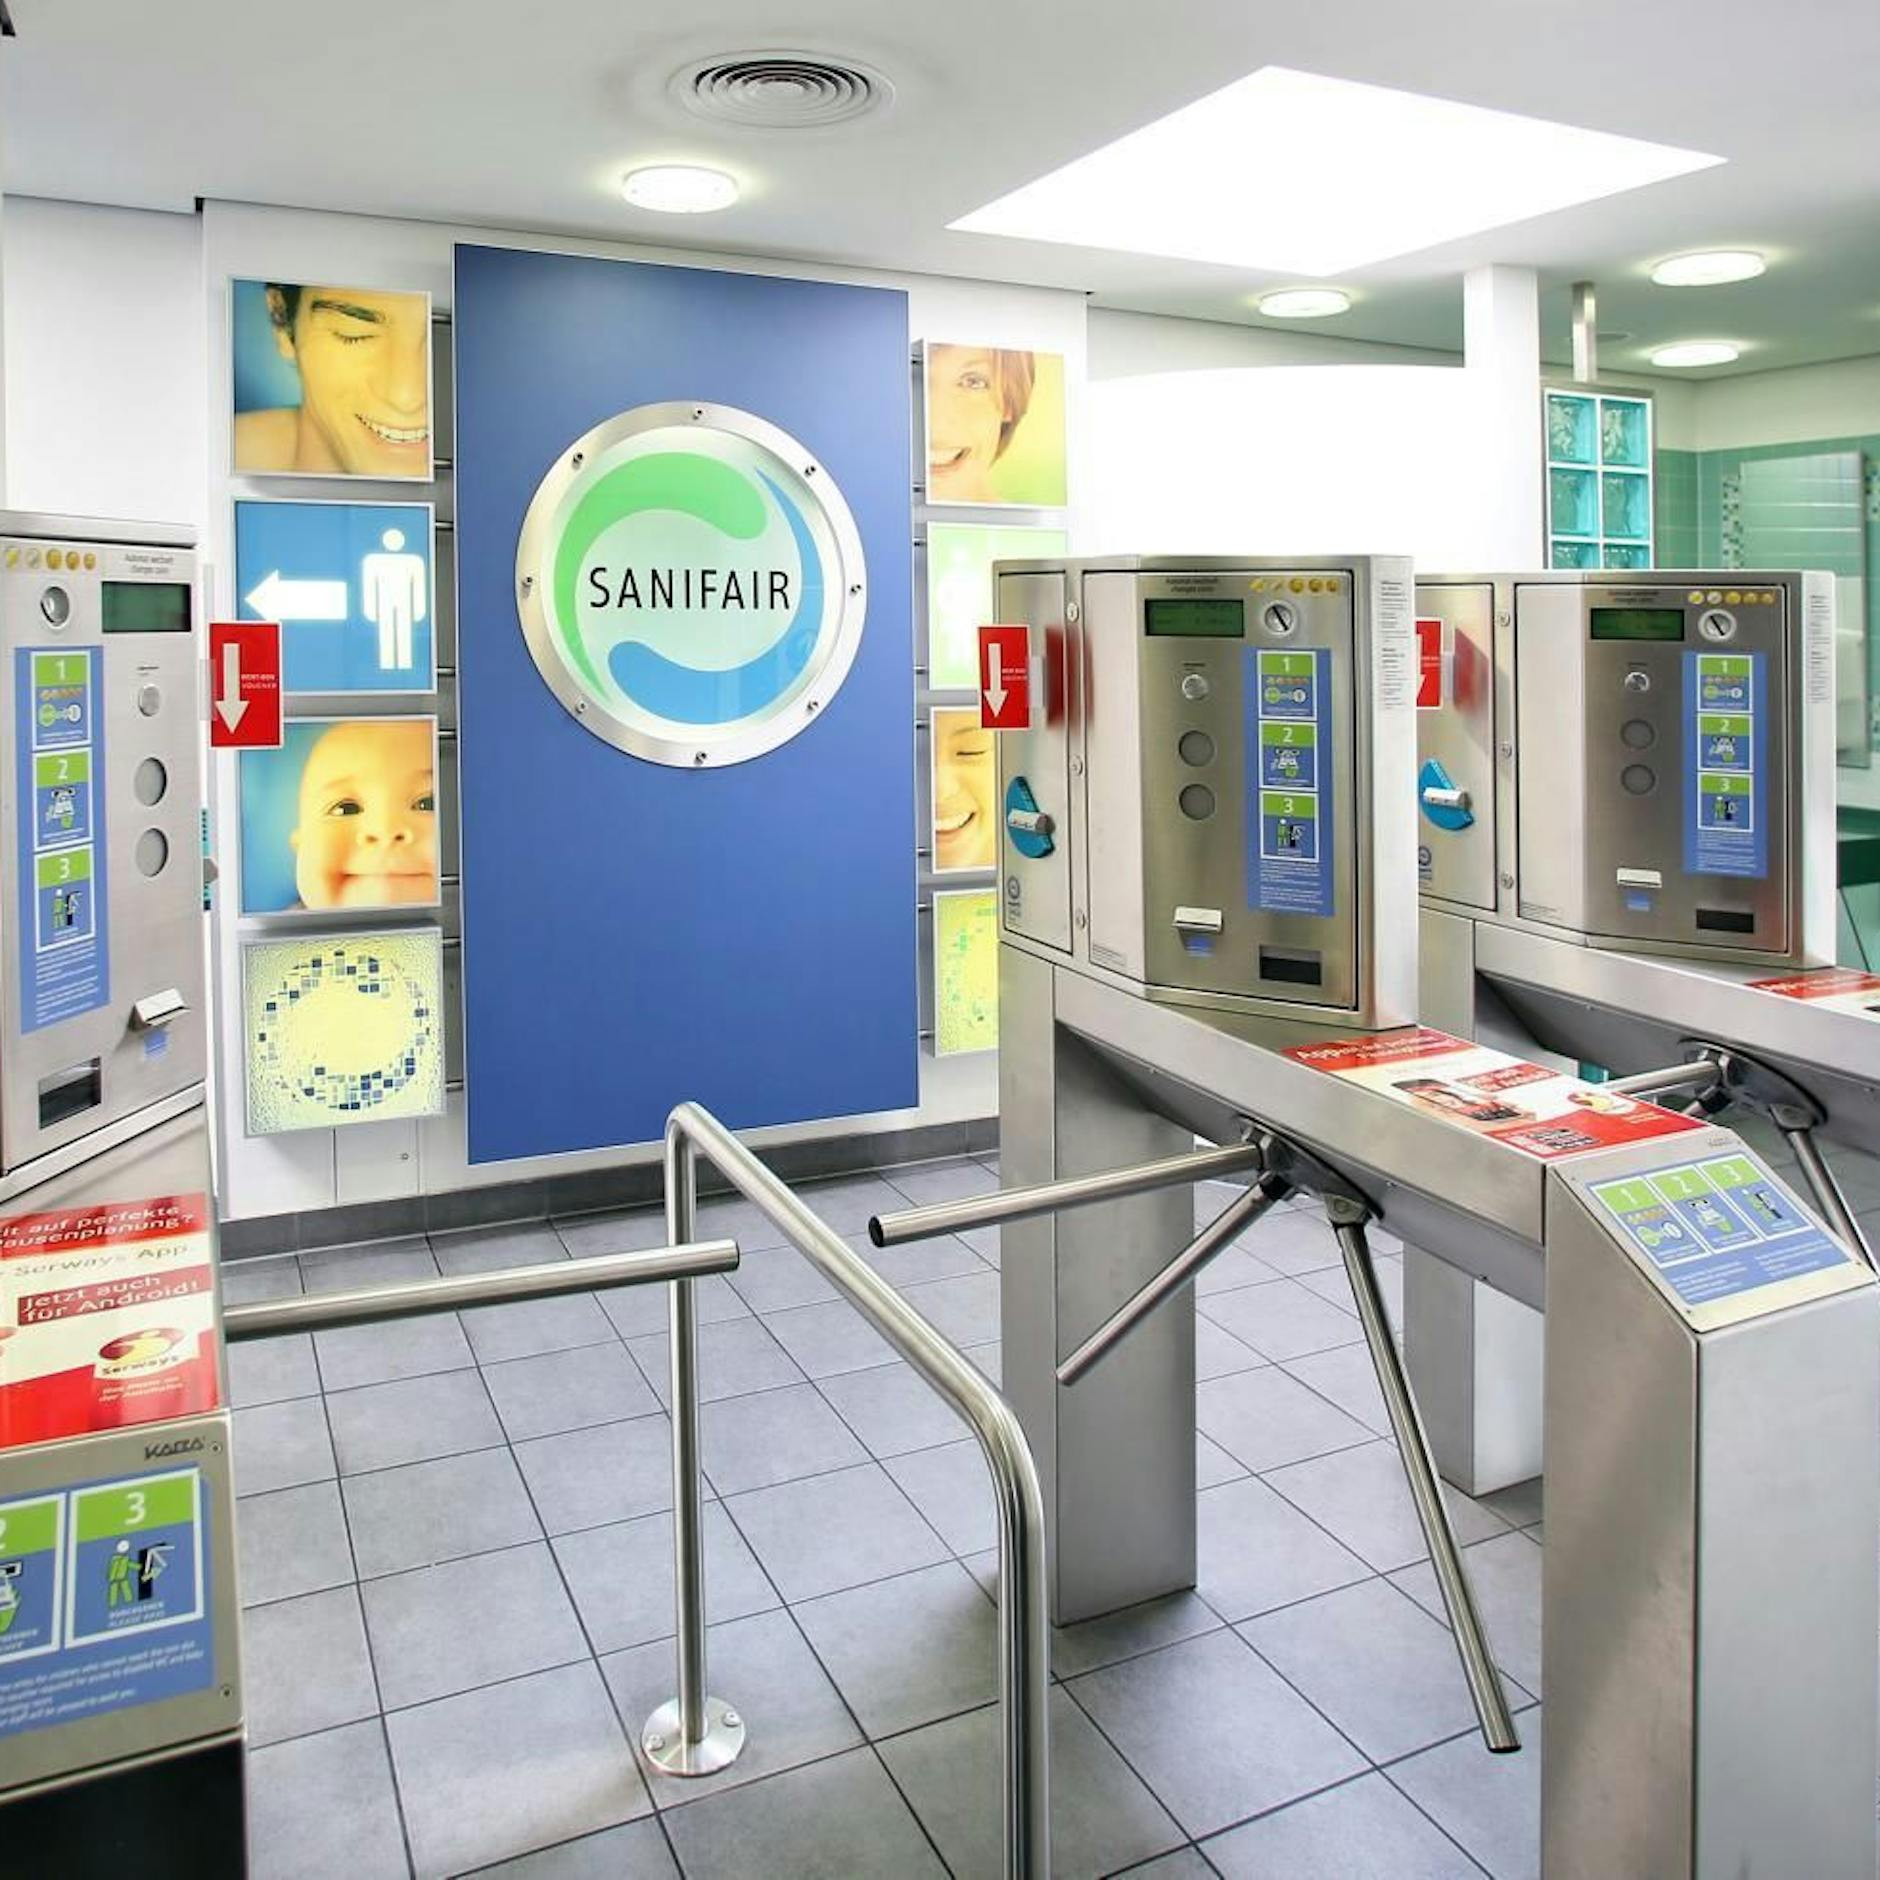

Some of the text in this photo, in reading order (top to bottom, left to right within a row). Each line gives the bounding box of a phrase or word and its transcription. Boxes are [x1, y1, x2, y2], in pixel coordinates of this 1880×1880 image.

[589, 567, 790, 610] SANIFAIR
[56, 661, 66, 680] 1
[1282, 656, 1291, 673] 1
[1720, 660, 1728, 673] 1
[1282, 727, 1294, 743] 2
[1720, 720, 1730, 733] 2
[58, 761, 68, 780] 2
[1720, 778, 1730, 792] 3
[1283, 797, 1294, 814] 3
[60, 858, 70, 879] 3
[1620, 1164, 1743, 1205] 1 2 3
[29, 1218, 69, 1234] auf
[77, 1205, 180, 1230] perfekte
[137, 1244, 189, 1259] App
[24, 1275, 161, 1312] Jetzt auch
[79, 1280, 199, 1312] Android!
[101, 1354, 181, 1376] Serways
[124, 1491, 147, 1525] 3
